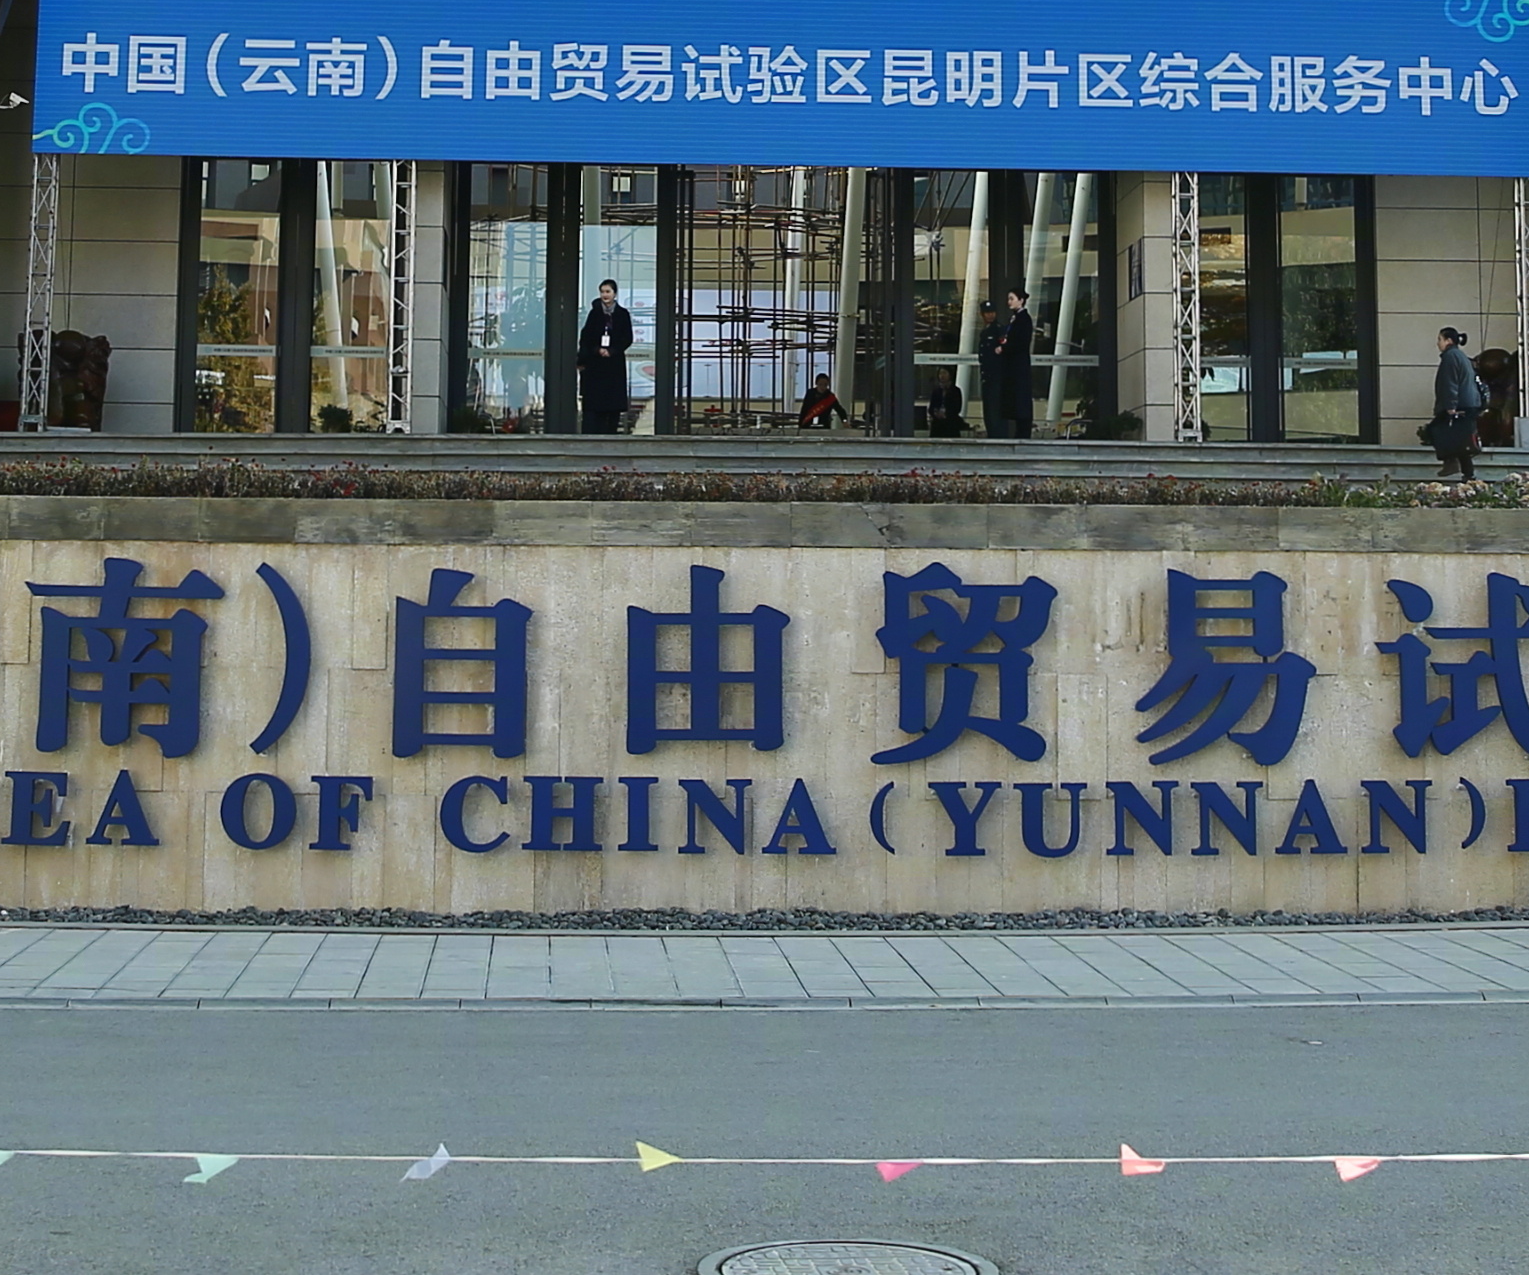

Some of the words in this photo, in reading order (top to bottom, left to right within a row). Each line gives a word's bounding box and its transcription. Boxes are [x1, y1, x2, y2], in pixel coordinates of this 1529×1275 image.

[60, 30, 1520, 116] 中国（云南）自由贸易试验区昆明片区综合服务中心
[219, 773, 374, 851] OF
[439, 775, 839, 856] CHINA
